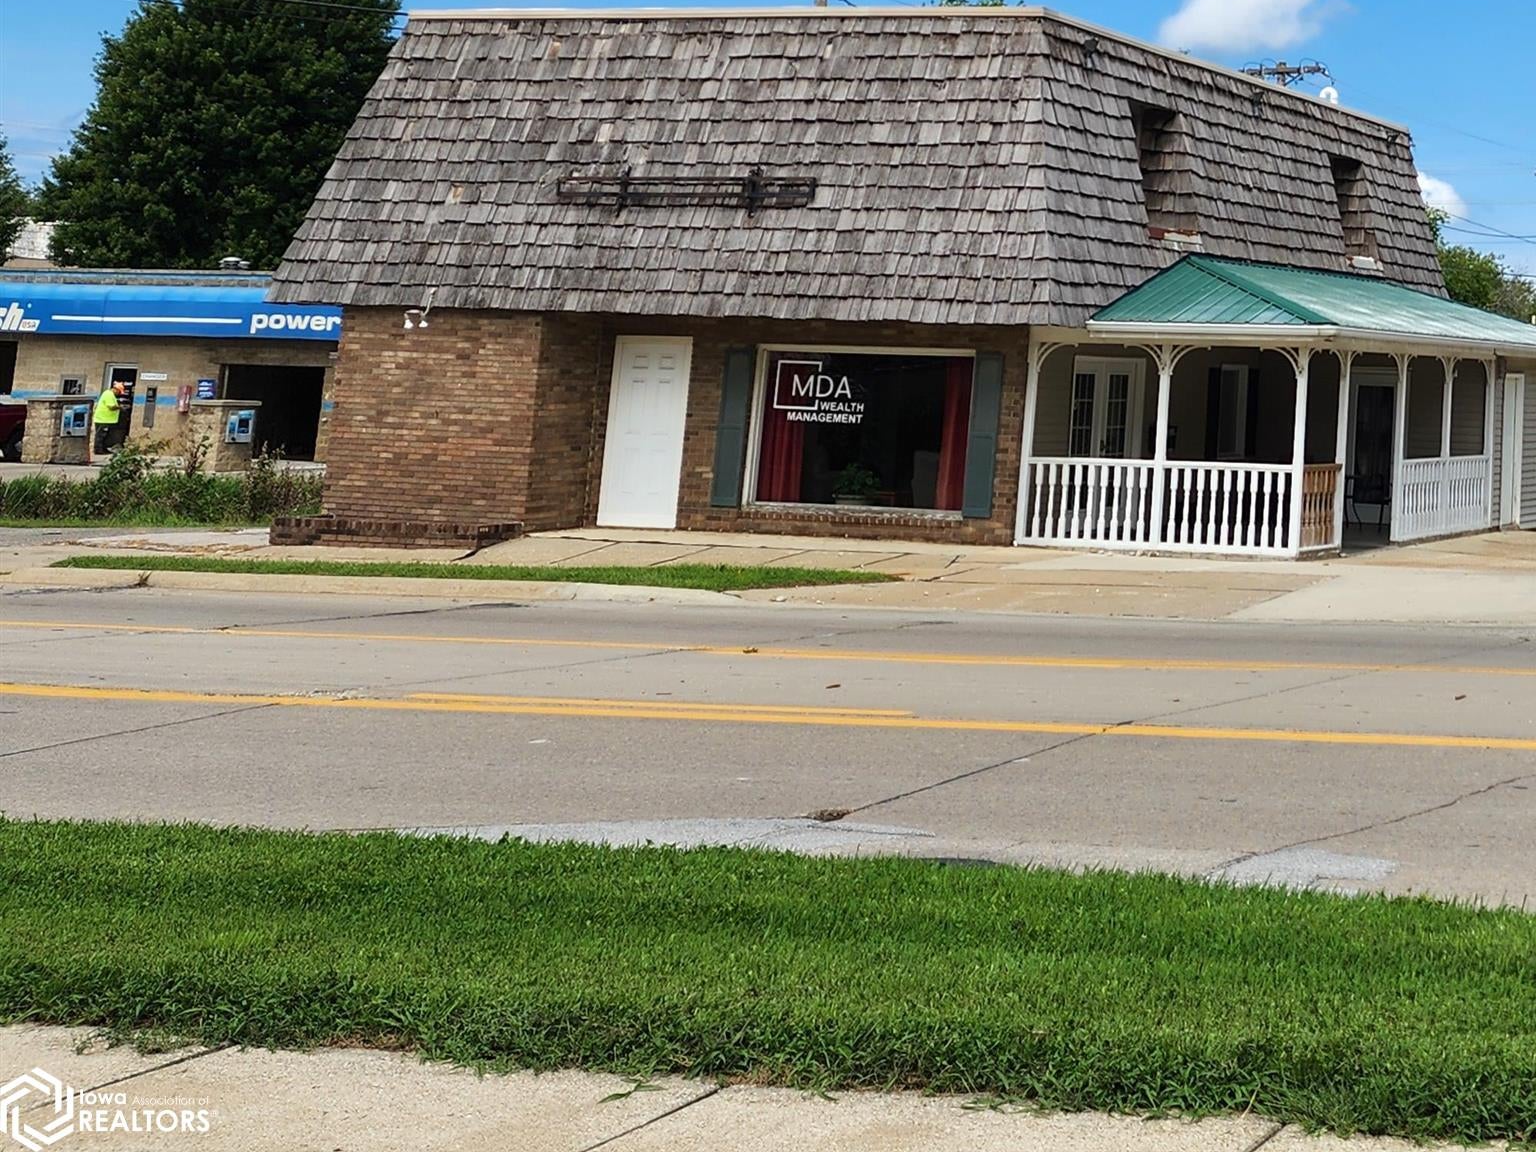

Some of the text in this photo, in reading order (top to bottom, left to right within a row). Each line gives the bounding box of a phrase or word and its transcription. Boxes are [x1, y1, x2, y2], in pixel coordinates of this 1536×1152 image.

[250, 314, 341, 334] power
[791, 374, 851, 399] MDA
[820, 401, 865, 412] WEALTH
[787, 411, 863, 424] MANAGEMENT
